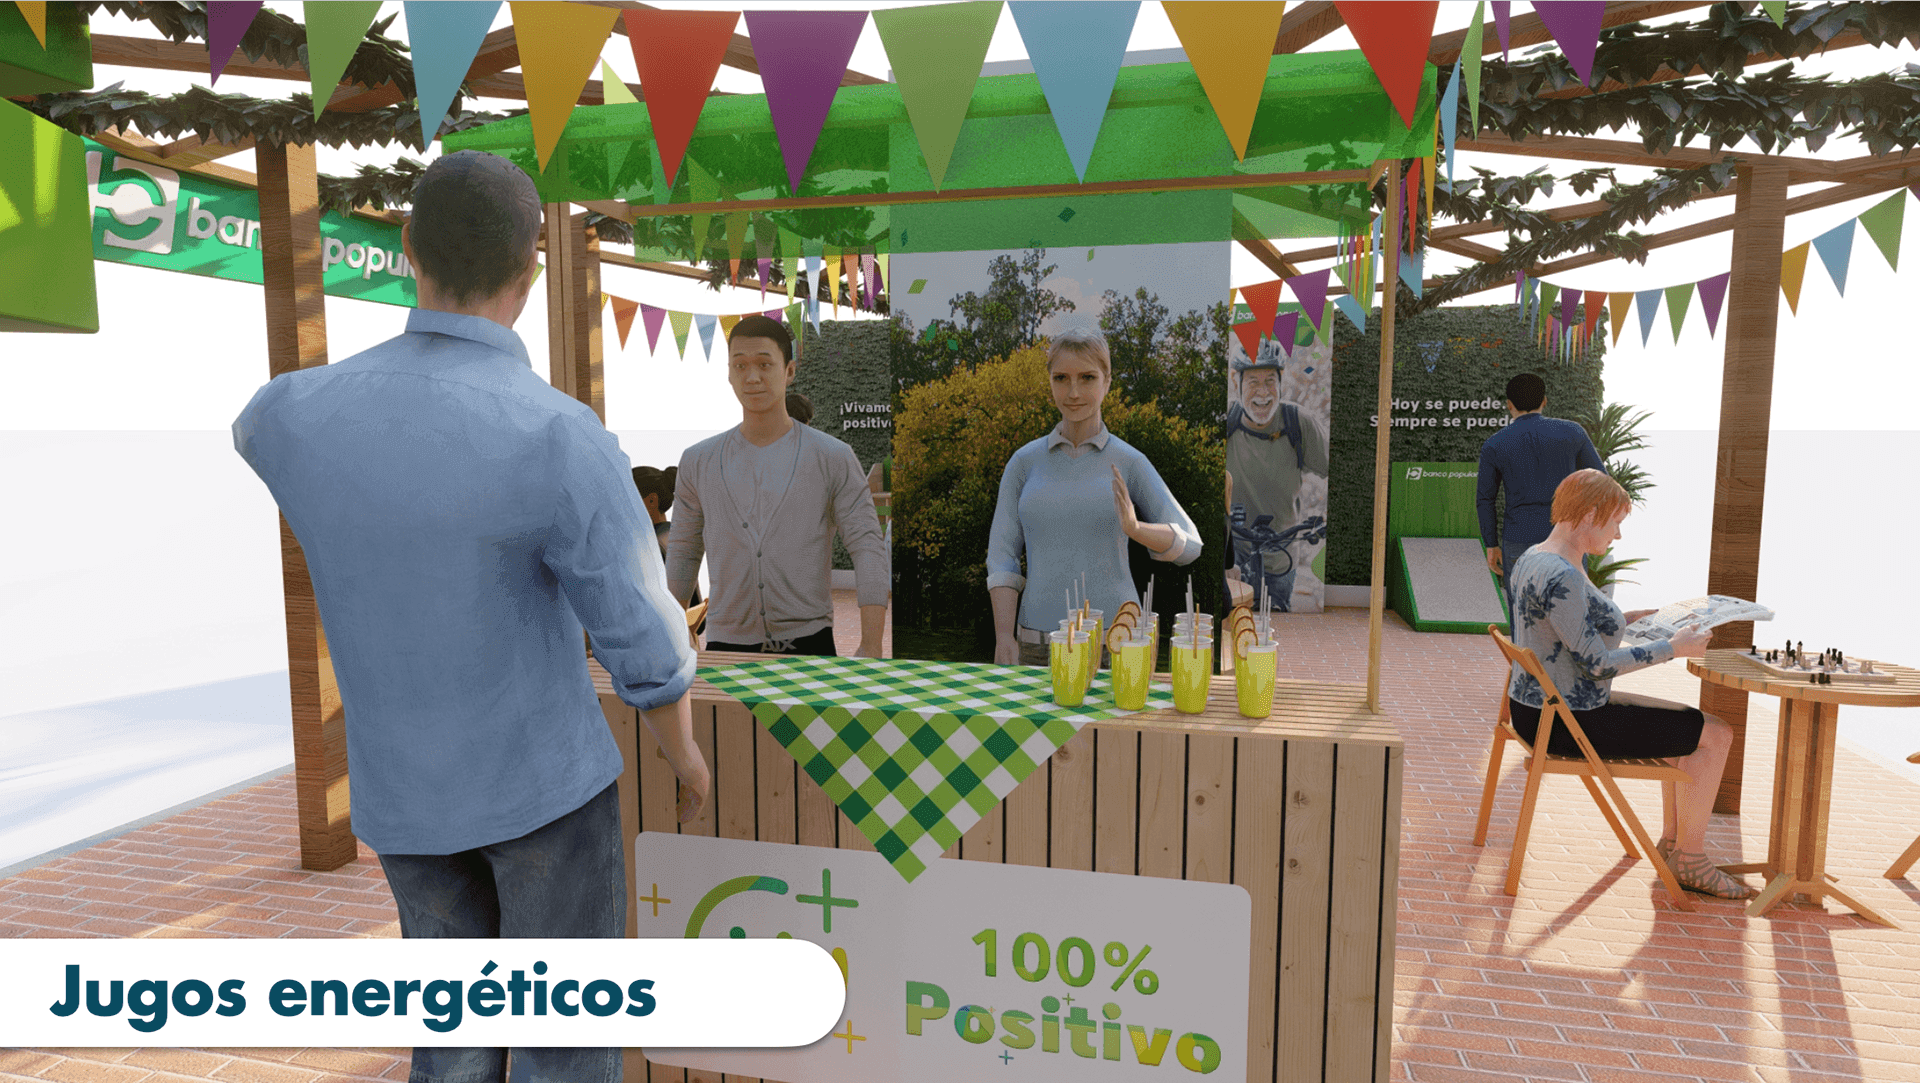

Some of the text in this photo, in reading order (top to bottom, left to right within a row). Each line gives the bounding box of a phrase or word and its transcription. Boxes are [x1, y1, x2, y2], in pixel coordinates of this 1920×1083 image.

[187, 197, 416, 280] ban popul
[840, 402, 892, 415] ¡Vivamo
[1390, 397, 1506, 413] Hoy se puede.
[843, 417, 891, 431] positiv
[1370, 415, 1437, 430] Sempre
[1443, 417, 1461, 427] se
[972, 928, 1159, 995] 100%
[906, 980, 1221, 1074] Positivo
